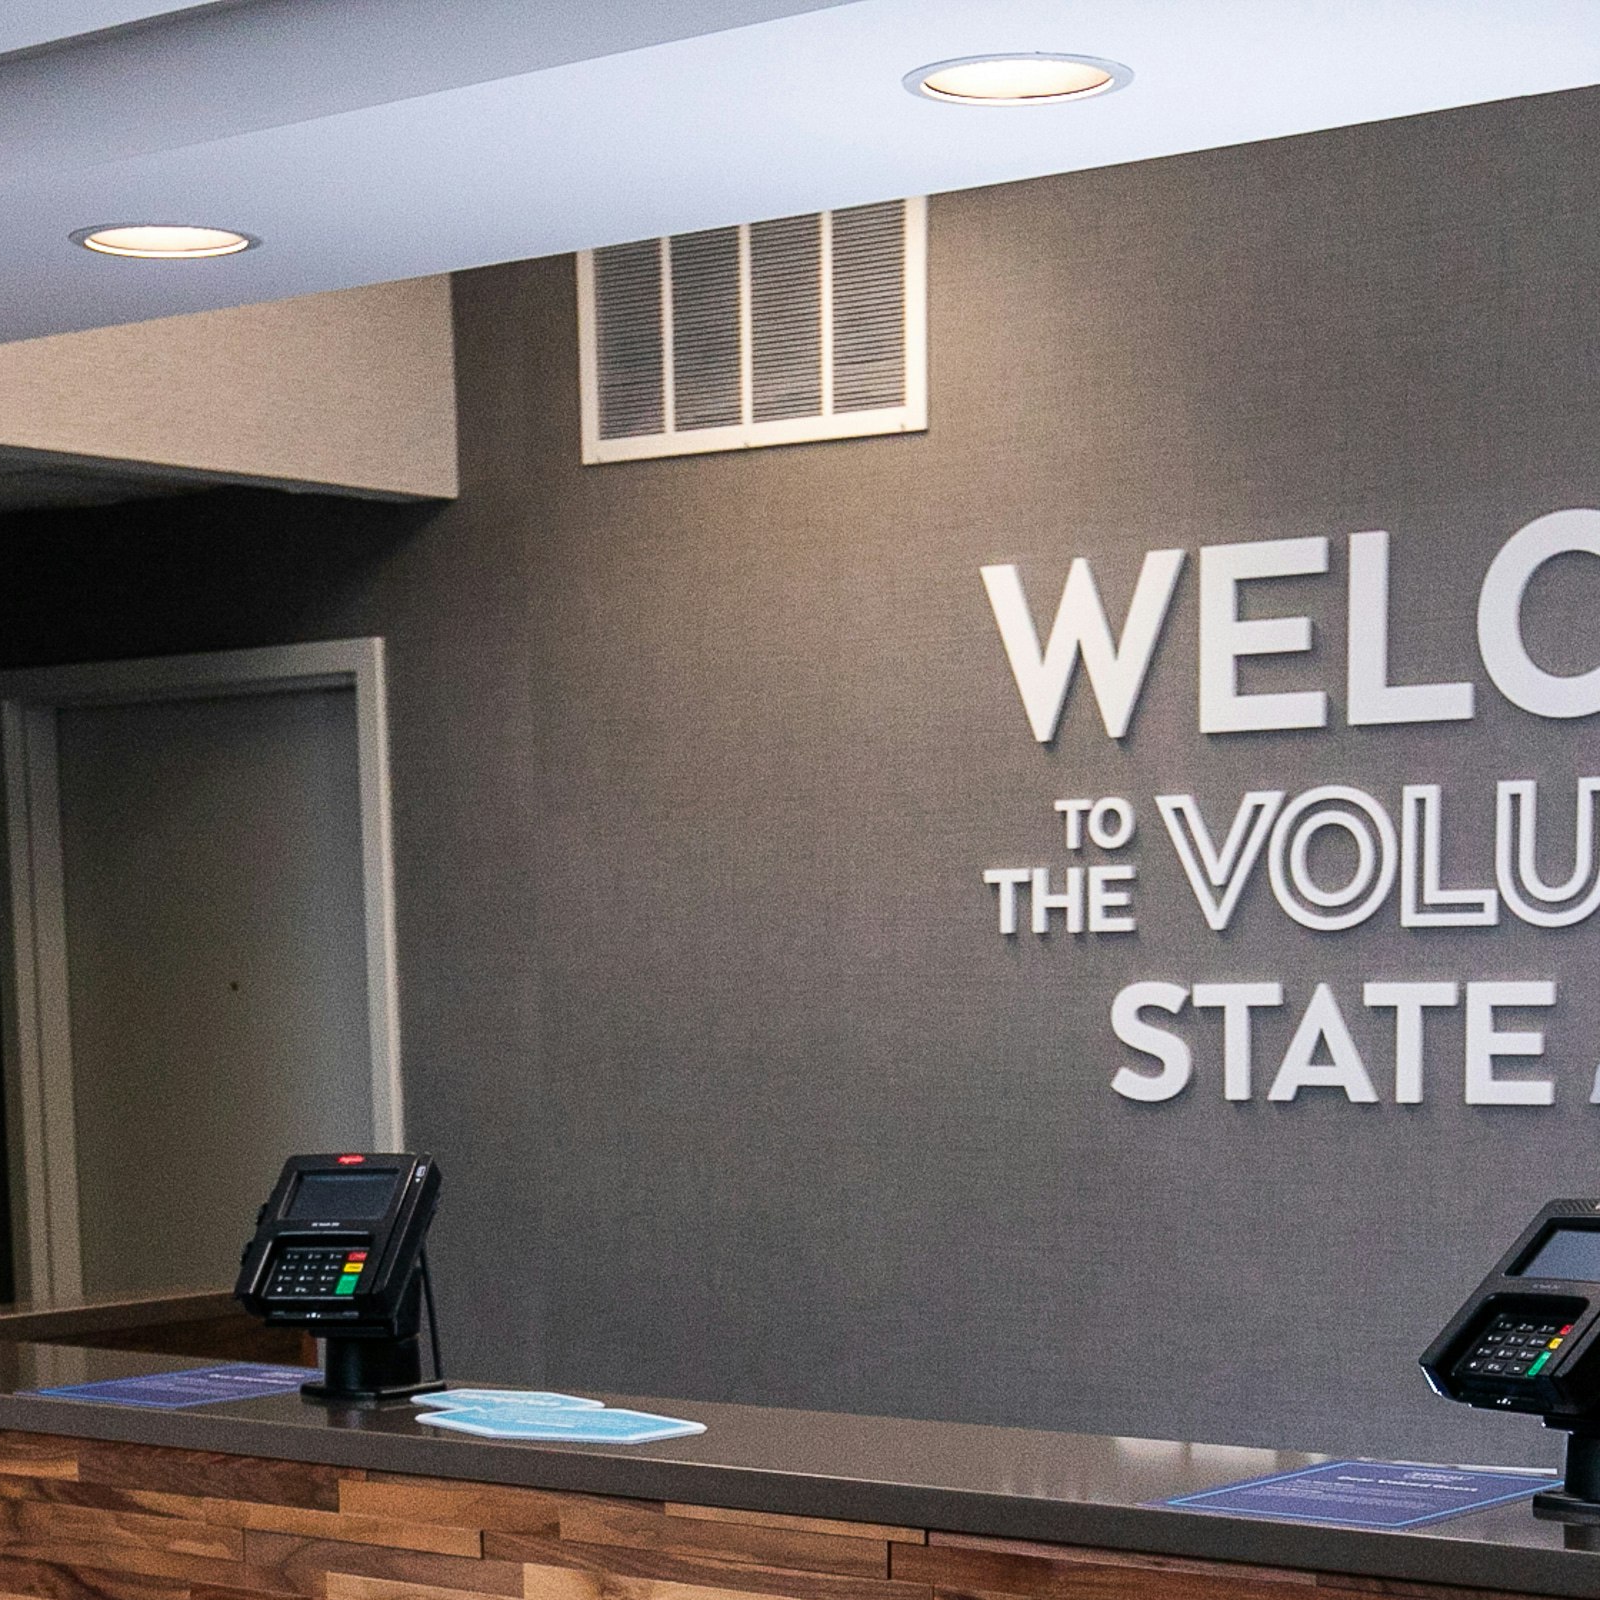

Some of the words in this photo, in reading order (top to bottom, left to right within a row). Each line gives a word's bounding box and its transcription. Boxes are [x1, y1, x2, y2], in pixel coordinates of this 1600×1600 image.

[1054, 796, 1135, 850] TO
[984, 865, 1136, 934] THE
[1111, 981, 1555, 1106] STATE
